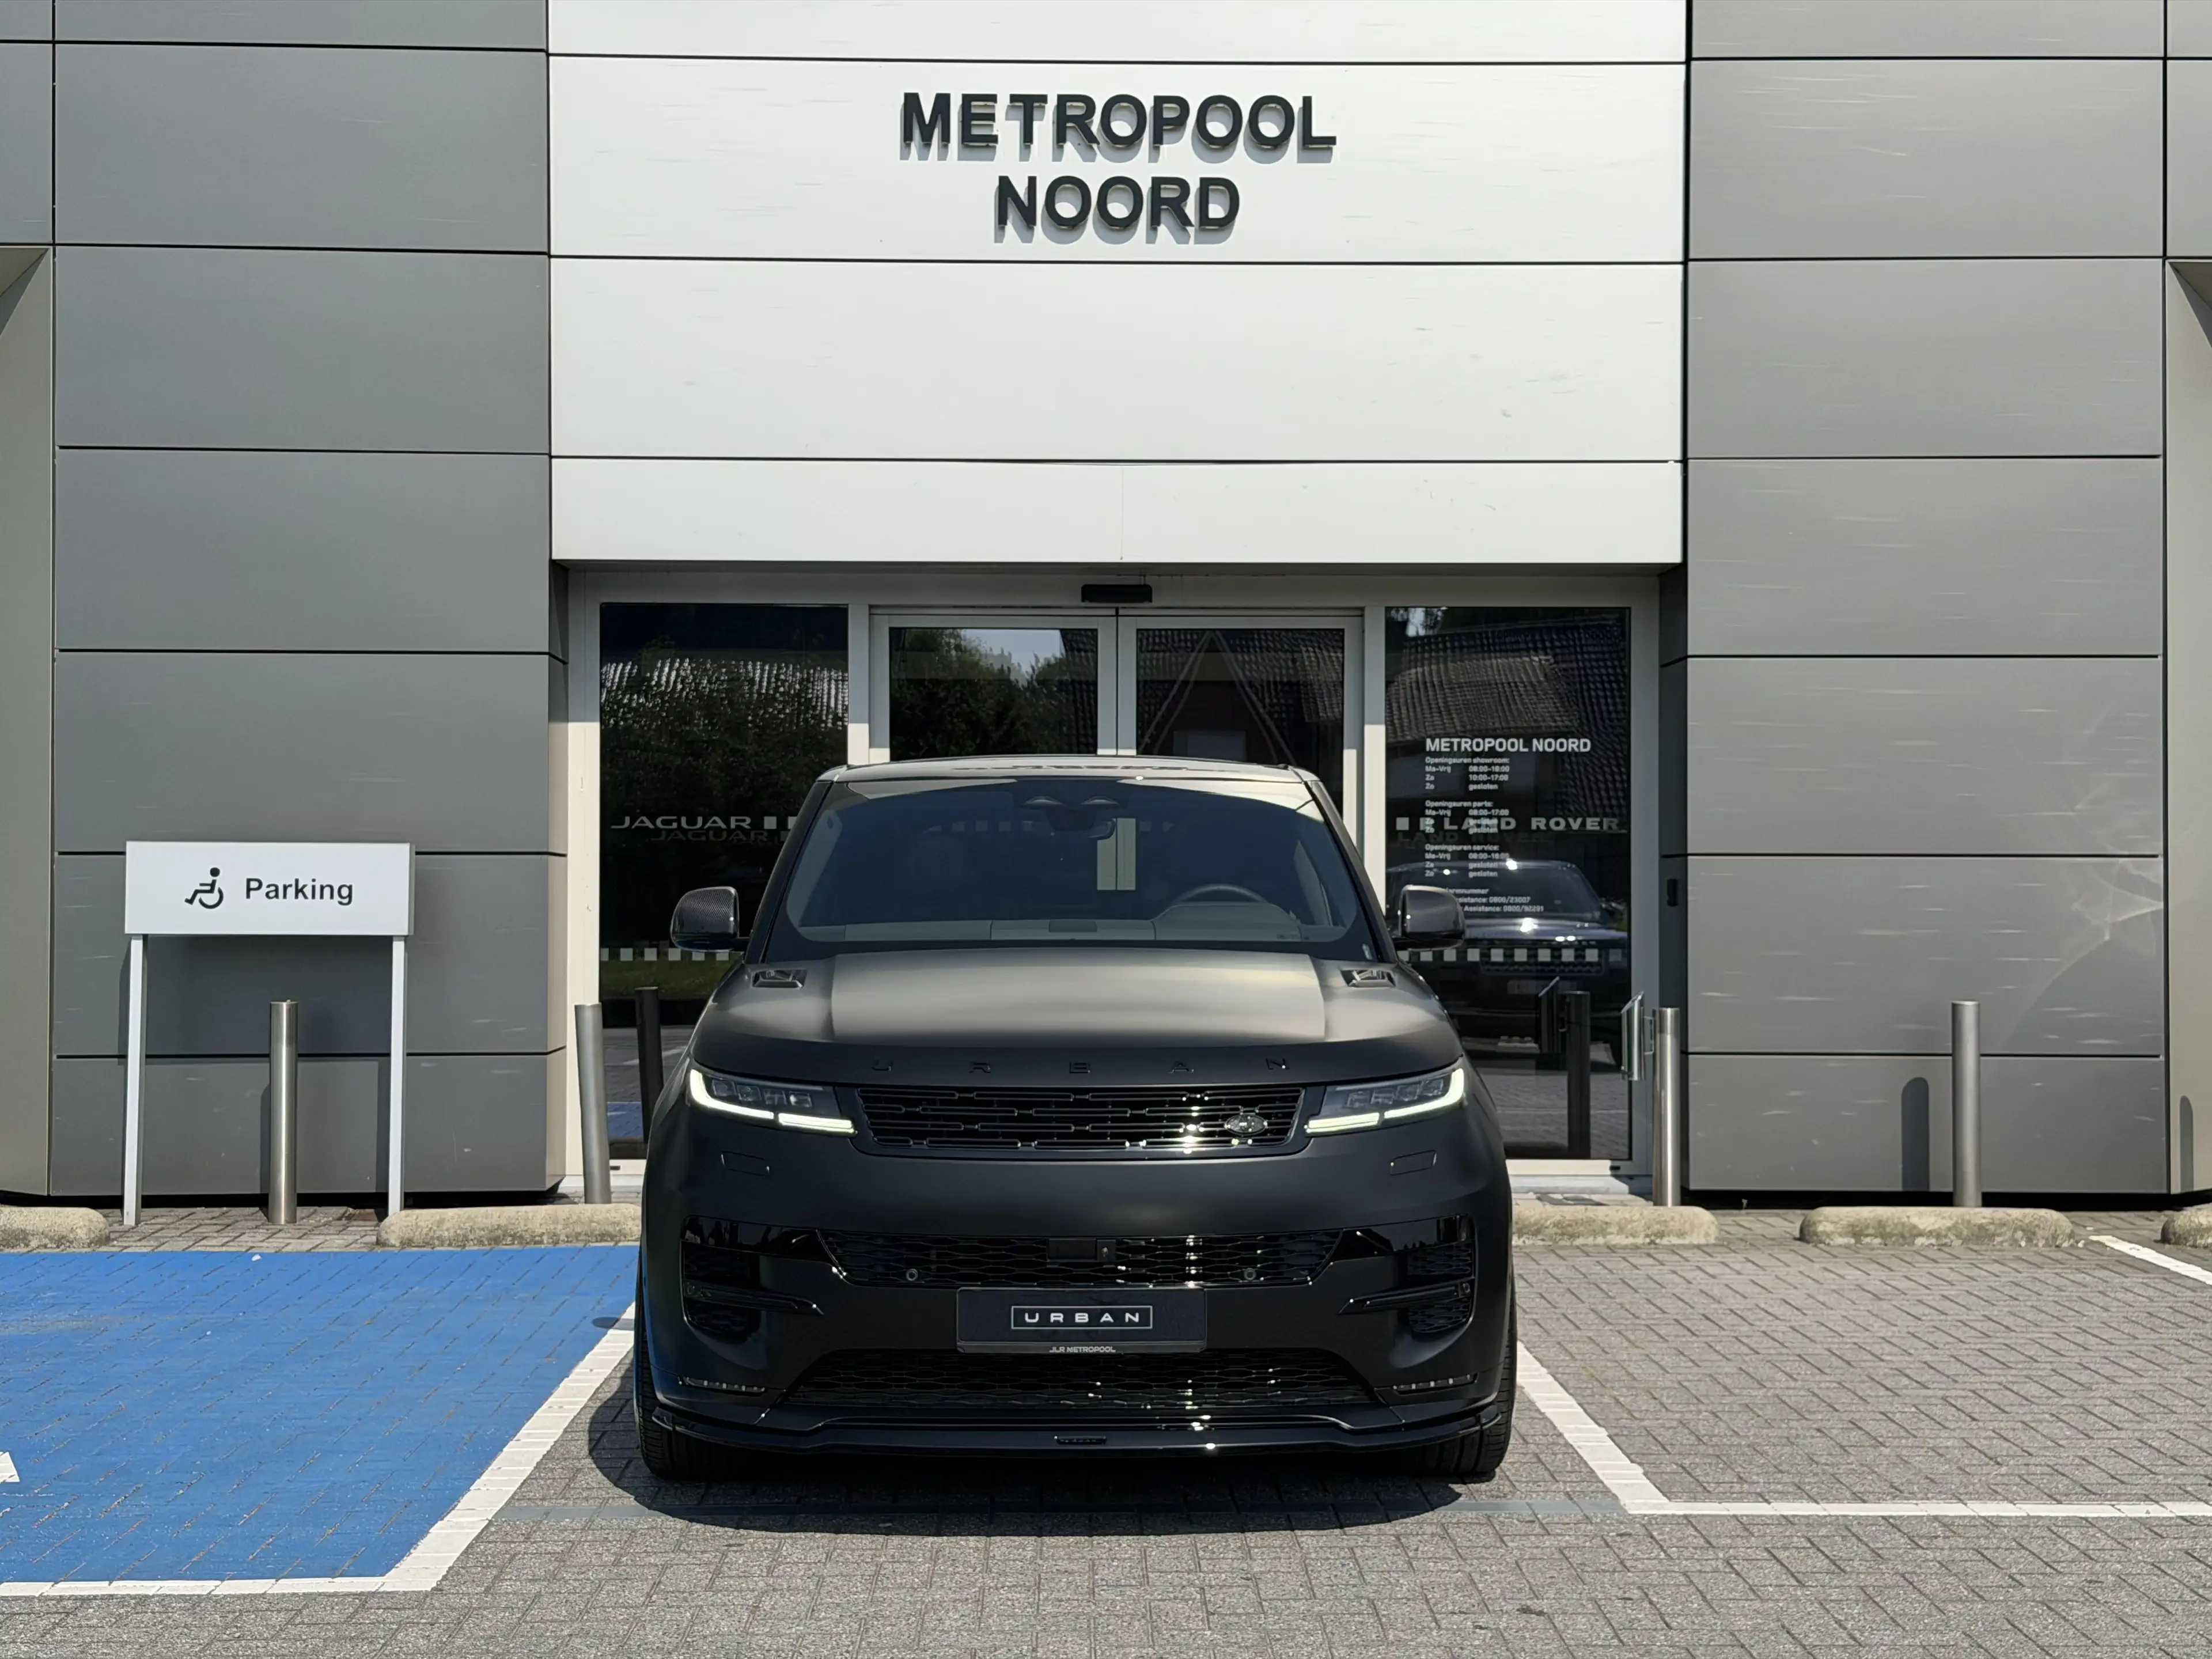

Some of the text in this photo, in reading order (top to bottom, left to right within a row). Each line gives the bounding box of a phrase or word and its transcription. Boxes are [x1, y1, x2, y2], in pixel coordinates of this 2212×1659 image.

[904, 92, 1336, 147] METROPOOL
[998, 175, 1239, 229] NOORD
[1426, 738, 1591, 752] METROPOOL NOORD
[1425, 756, 1471, 764] Openingsuren
[1468, 783, 1498, 791] gesloten
[1425, 809, 1451, 817] Ma-Vrij
[611, 816, 751, 829] JAGUAR
[1444, 817, 1619, 830] LAND ROVER
[651, 831, 768, 840] JAGUAR
[1425, 853, 1450, 861] Ma-Vrij
[1468, 870, 1498, 878] gesloten
[245, 878, 353, 906] Parking
[872, 1058, 1290, 1073] URBAN
[1025, 1313, 1139, 1323] URBAN
